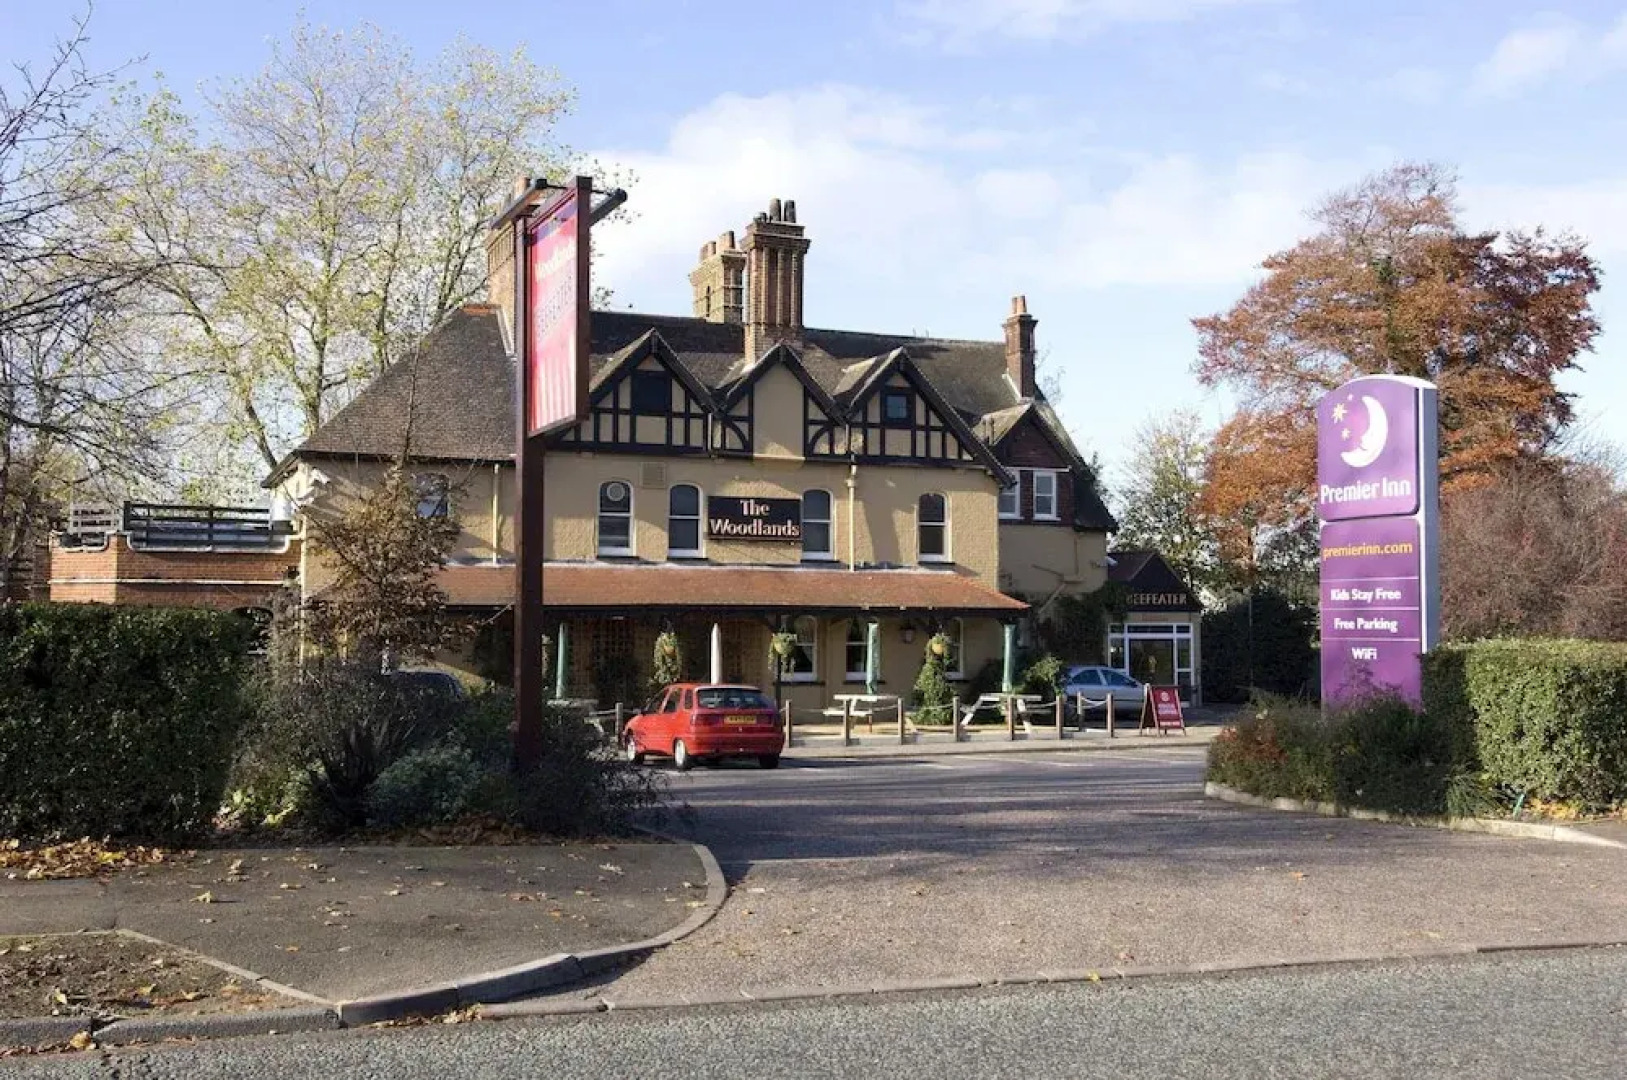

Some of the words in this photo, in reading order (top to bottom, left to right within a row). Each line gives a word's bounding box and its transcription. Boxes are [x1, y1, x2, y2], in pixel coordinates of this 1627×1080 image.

[1320, 479, 1380, 504] Premier
[1382, 477, 1411, 497] Inn
[740, 499, 770, 516] The
[709, 518, 800, 536] Woodlands
[1322, 542, 1412, 561] premierinn.com
[1331, 588, 1350, 601] Kids
[1351, 588, 1373, 604] Stay
[1375, 587, 1402, 600] Free
[1334, 617, 1355, 630] Free
[1356, 617, 1398, 633] Parking
[1352, 647, 1377, 660] WiFi
